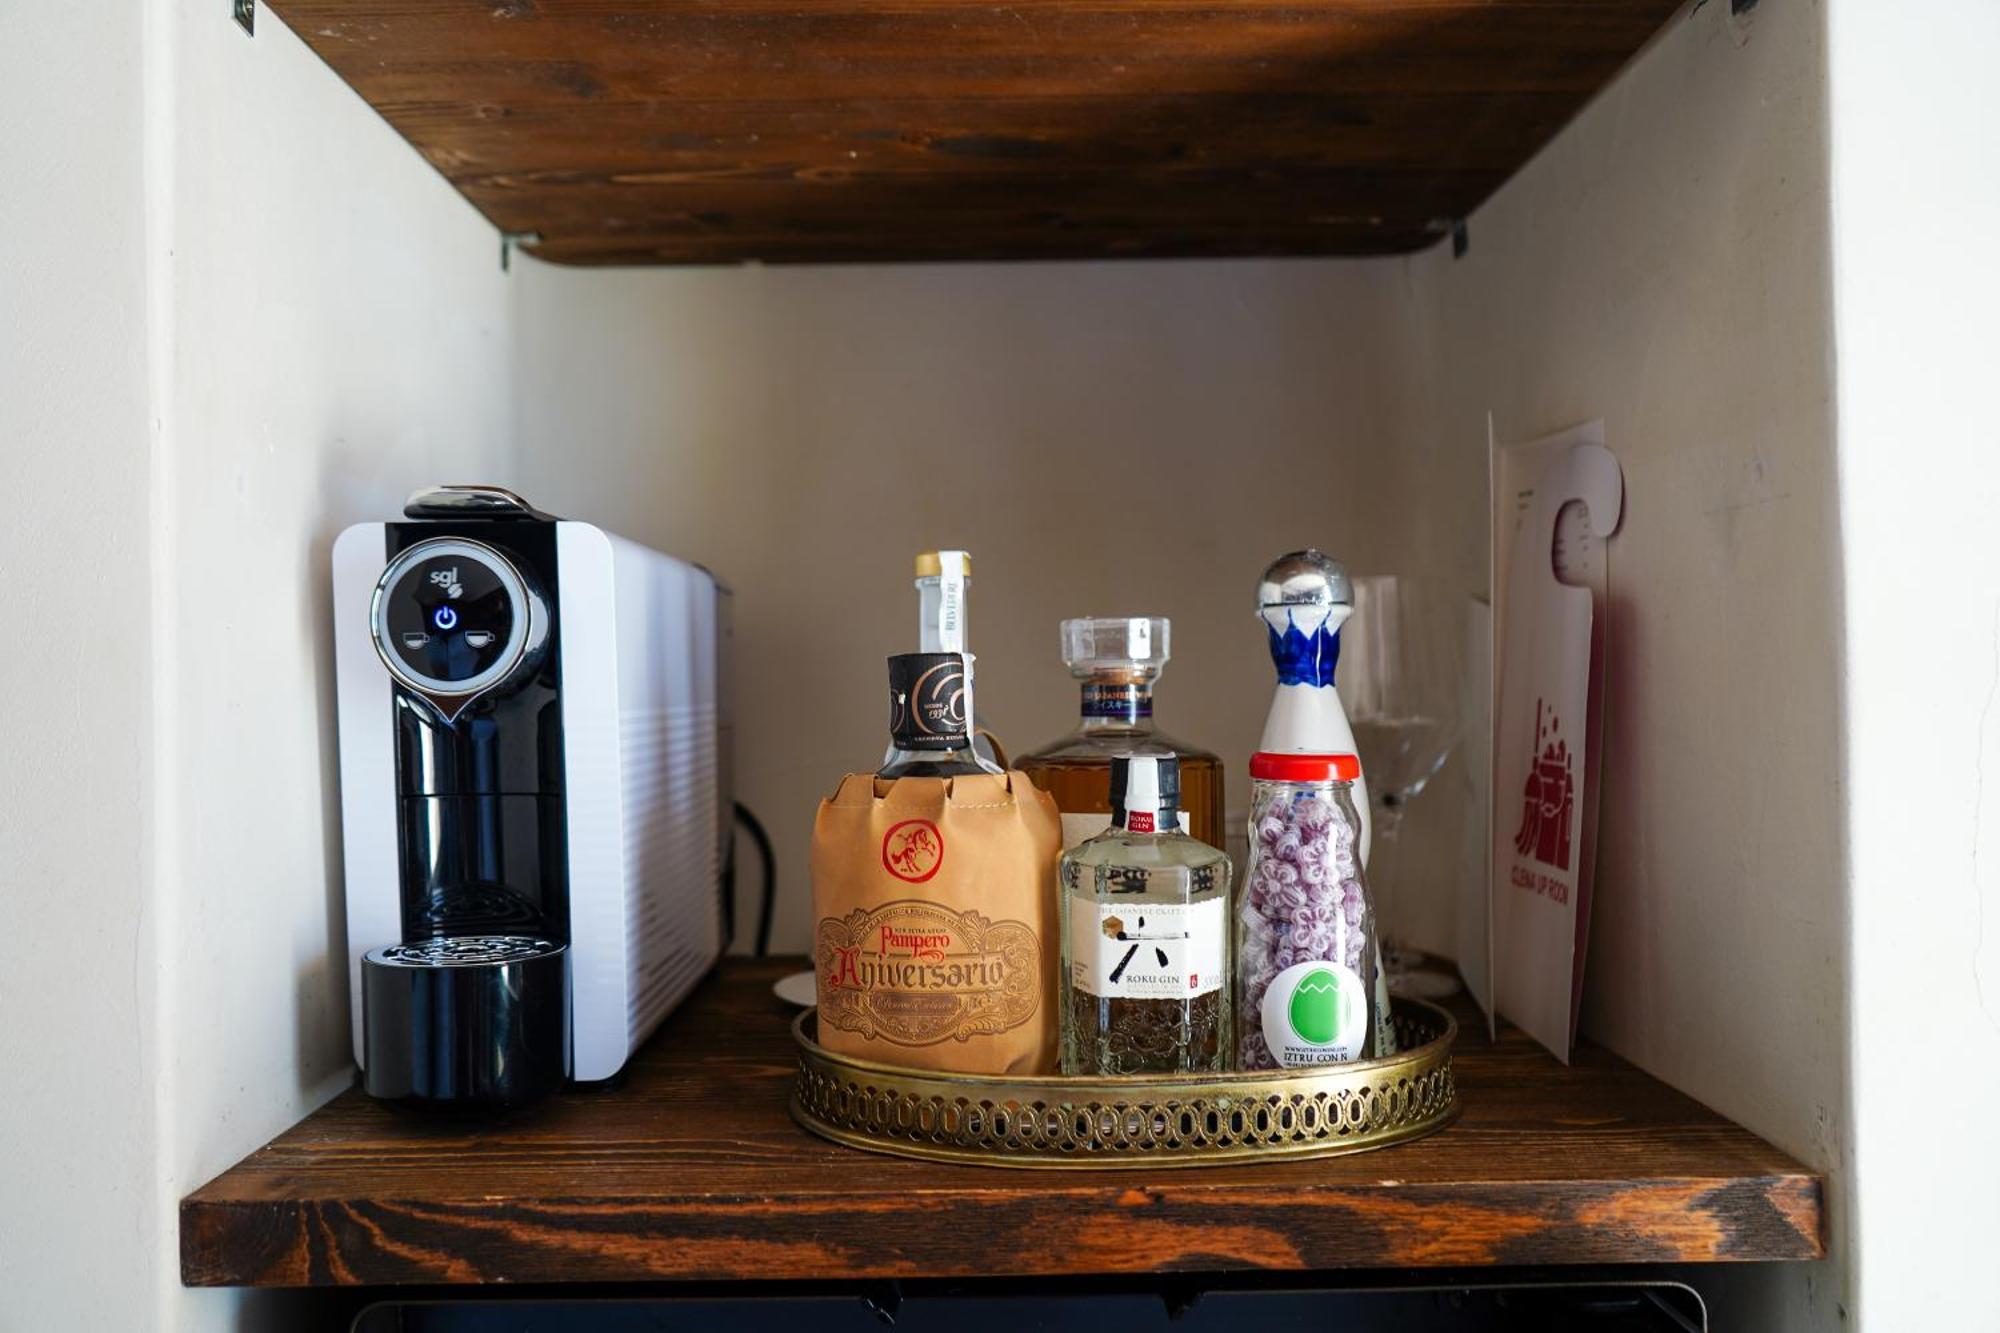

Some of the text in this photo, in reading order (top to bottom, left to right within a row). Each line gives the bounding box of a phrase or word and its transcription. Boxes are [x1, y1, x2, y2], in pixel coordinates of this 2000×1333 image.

[430, 567, 457, 587] sgl
[881, 925, 949, 960] Pampero
[829, 947, 1004, 992] Aniversario
[1126, 975, 1180, 983] ROKU GIN
